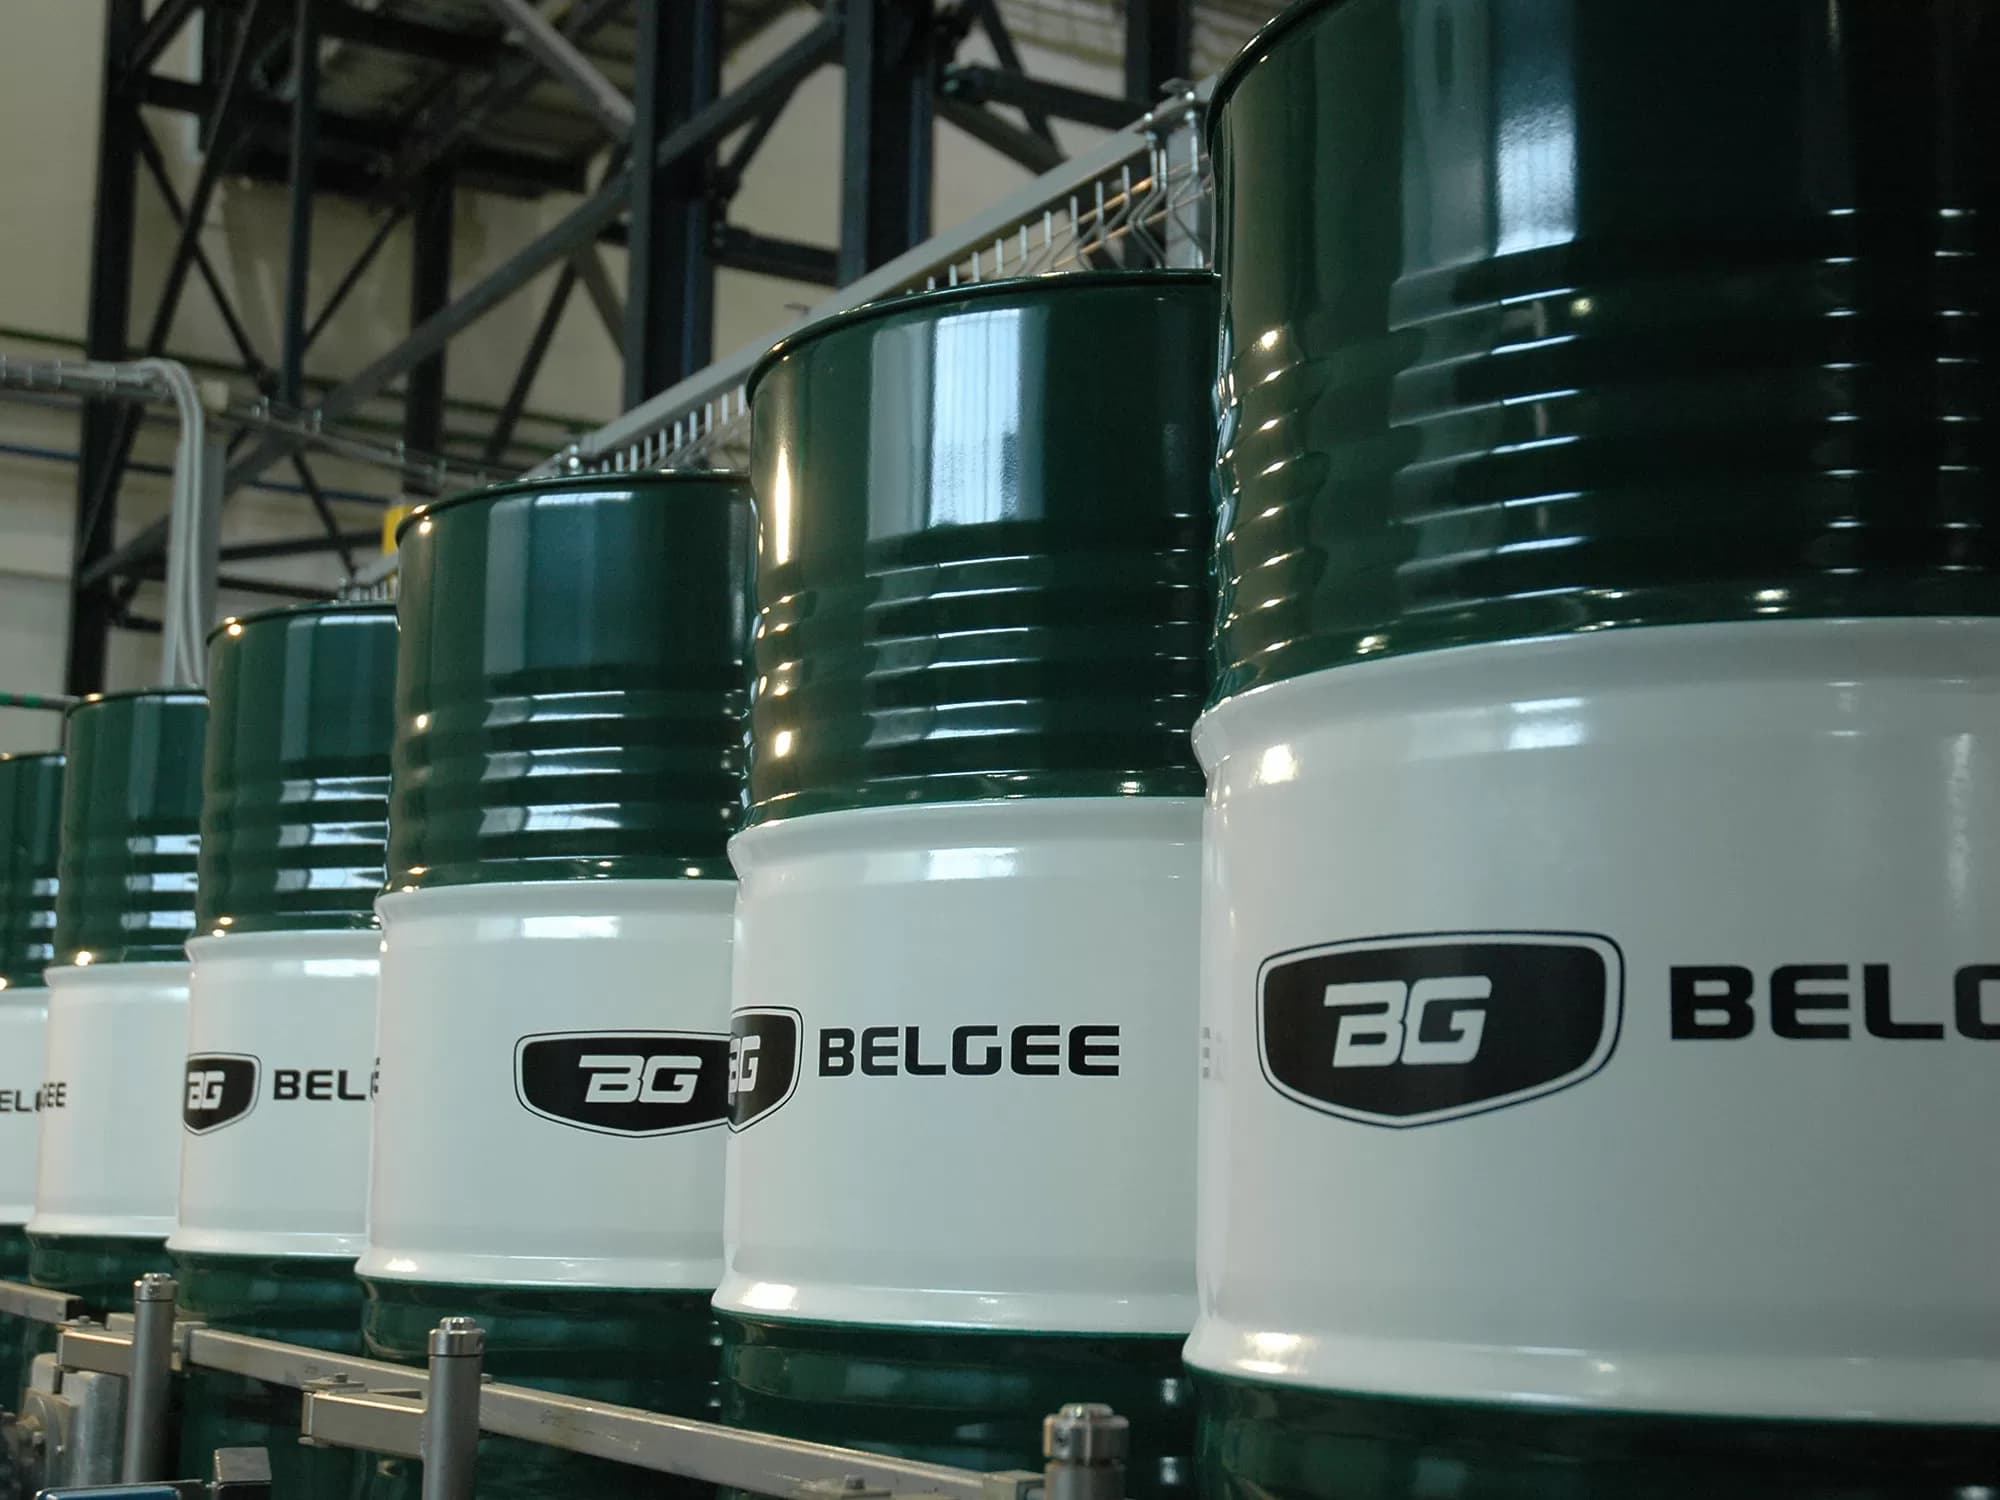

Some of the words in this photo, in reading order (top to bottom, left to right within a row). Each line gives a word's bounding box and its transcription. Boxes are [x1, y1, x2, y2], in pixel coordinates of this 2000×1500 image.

[1323, 975, 1492, 1068] BG
[819, 1024, 1120, 1077] BELGEE
[273, 1069, 375, 1101] BEL
[578, 1055, 703, 1104] BG
